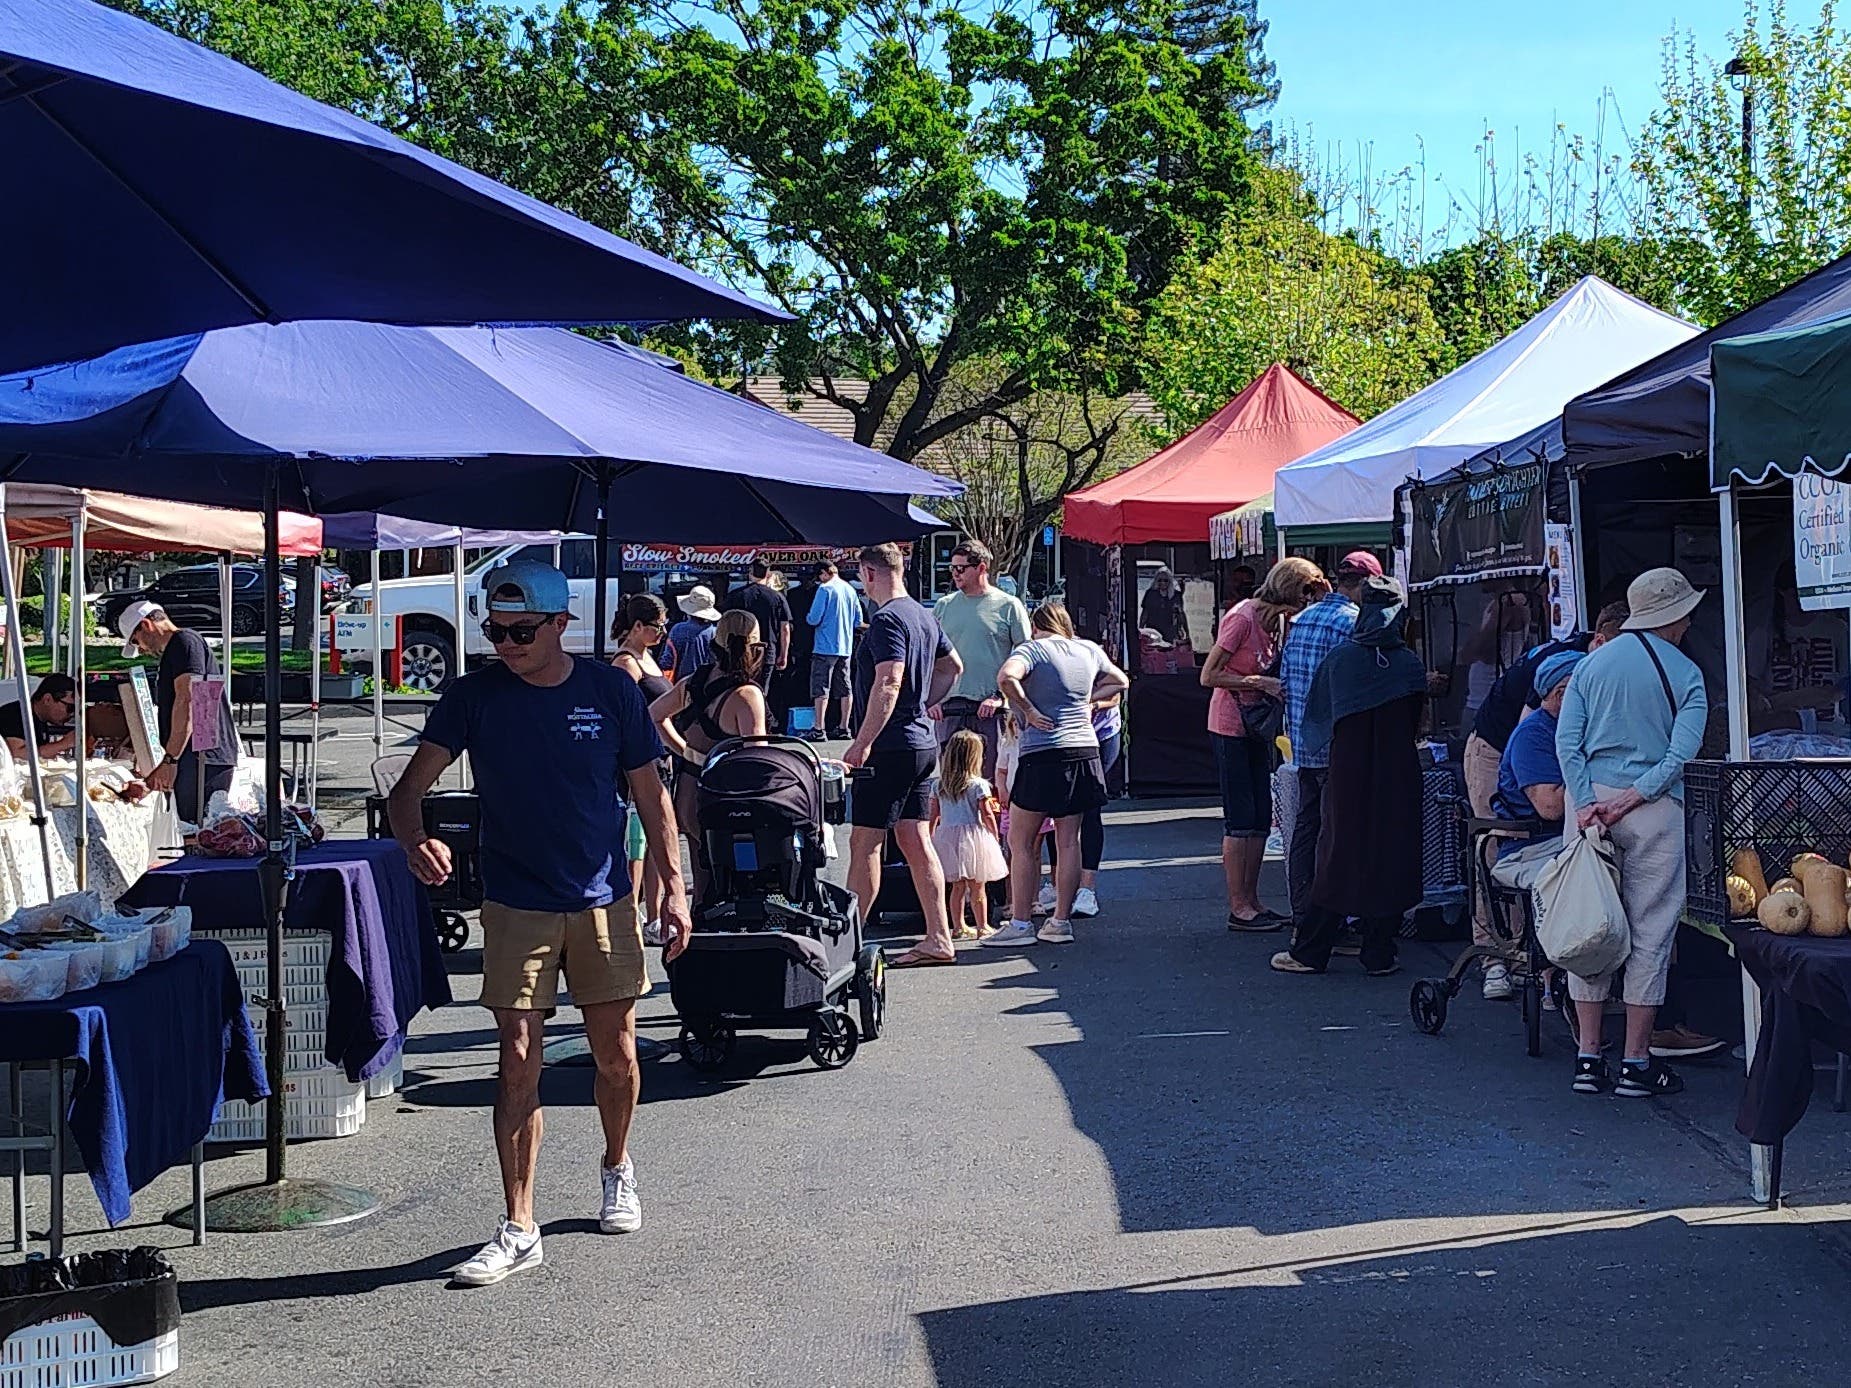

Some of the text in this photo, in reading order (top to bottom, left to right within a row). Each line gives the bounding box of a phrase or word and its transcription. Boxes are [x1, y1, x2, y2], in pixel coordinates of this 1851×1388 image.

[1799, 505, 1845, 530] Certified
[623, 544, 673, 562] Slow
[676, 546, 757, 565] Smoked
[800, 550, 829, 562] OAK
[1800, 535, 1846, 566] Organic
